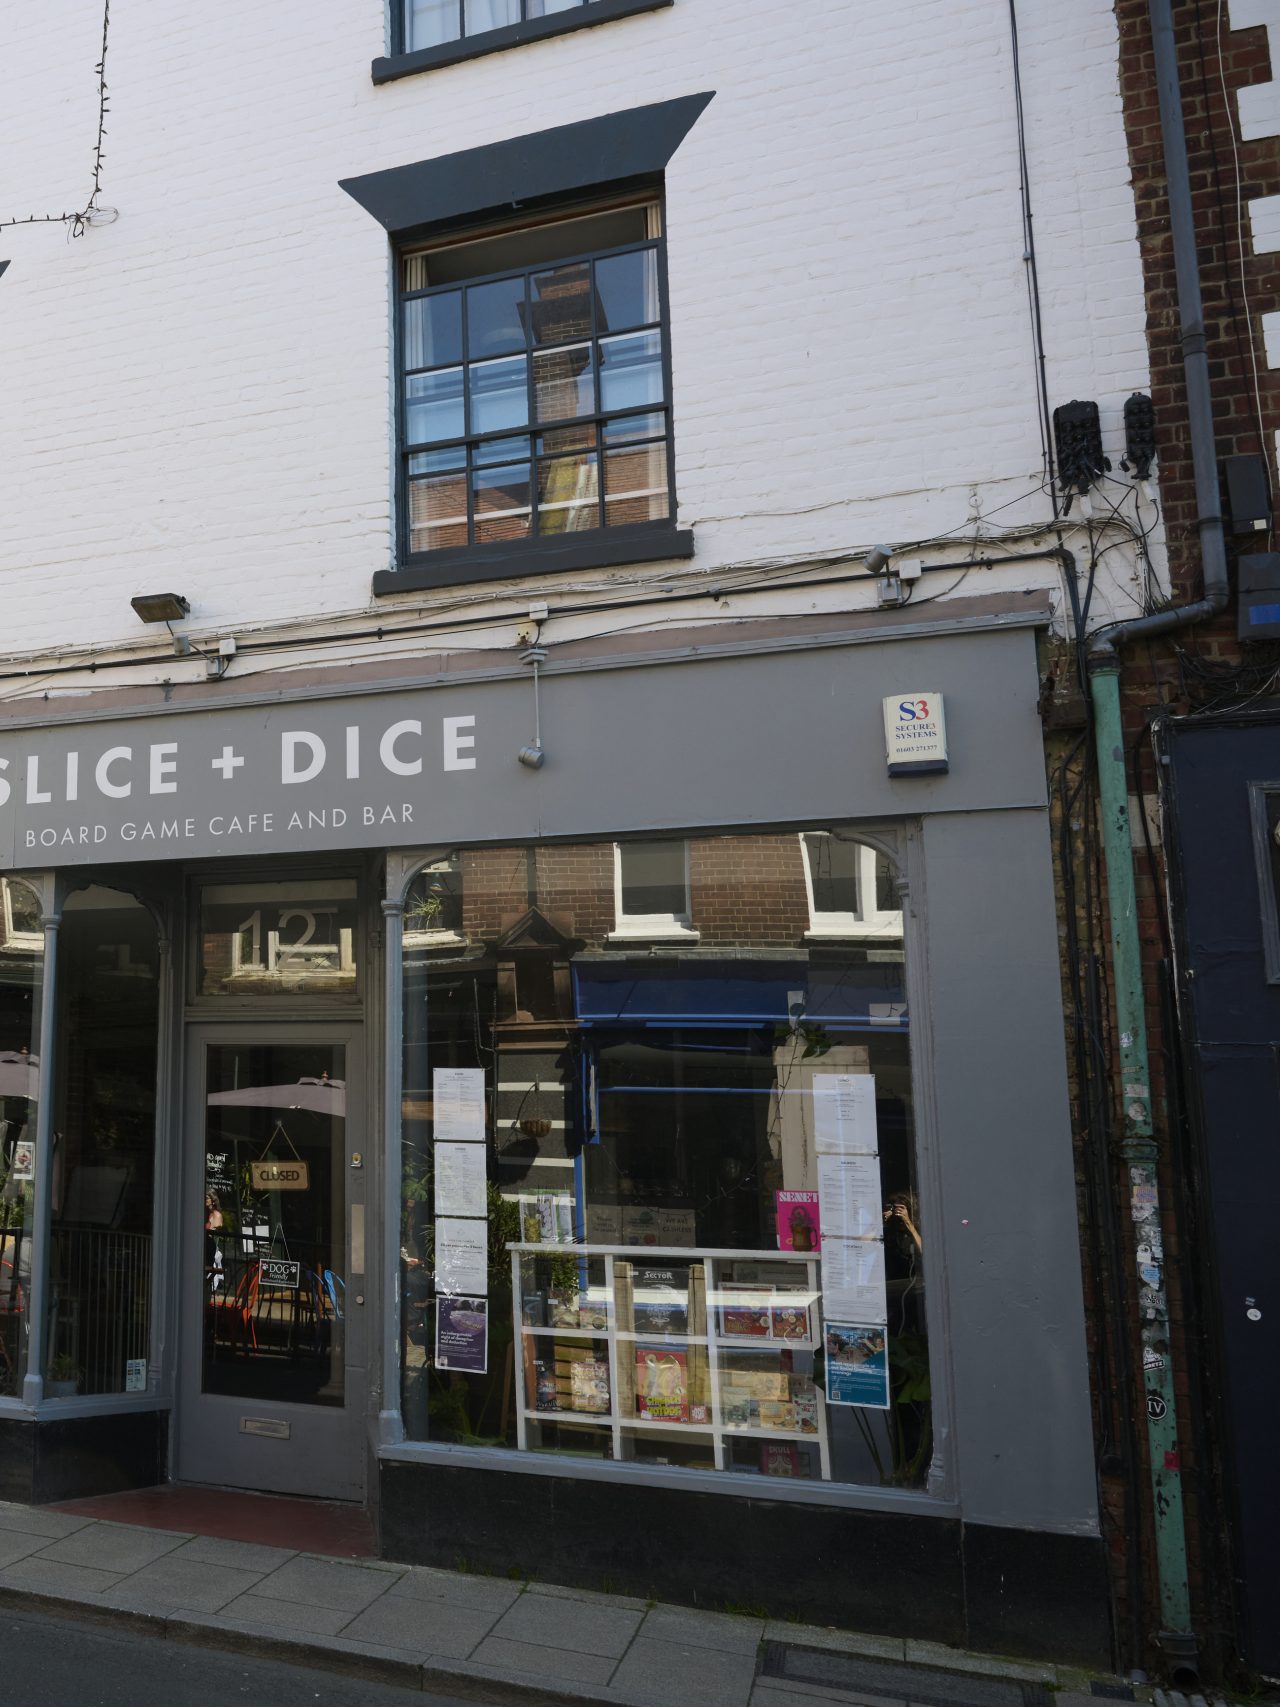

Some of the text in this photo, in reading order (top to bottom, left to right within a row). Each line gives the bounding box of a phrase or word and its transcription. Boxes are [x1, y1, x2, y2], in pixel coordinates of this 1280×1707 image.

[899, 700, 929, 721] S3
[895, 731, 937, 739] SYSTEMS
[211, 746, 245, 779] +
[281, 715, 477, 785] DICE
[26, 803, 415, 848] BOARD GAME CAFE AND BAR
[238, 909, 317, 971] 12
[260, 1170, 300, 1182] CLOSED
[269, 1263, 290, 1274] DOG
[1147, 1401, 1163, 1414] IV
